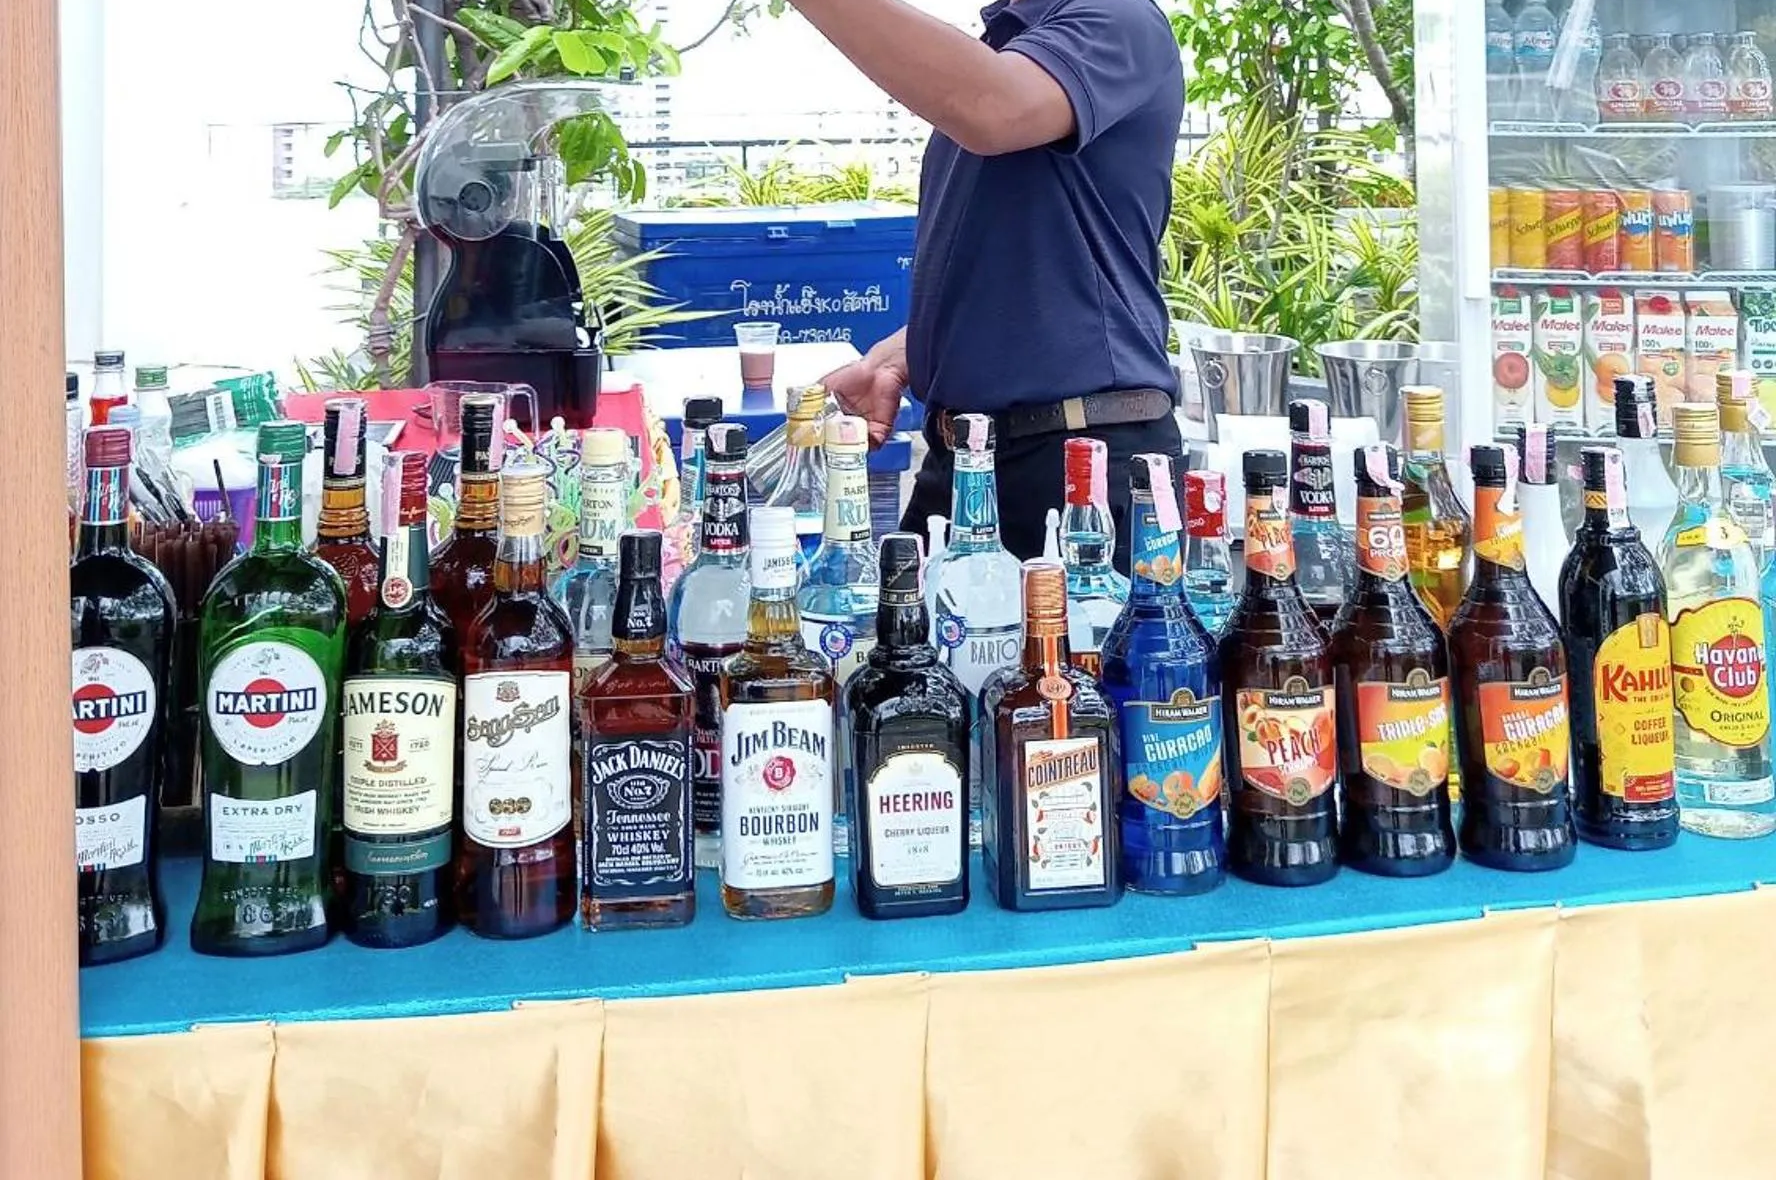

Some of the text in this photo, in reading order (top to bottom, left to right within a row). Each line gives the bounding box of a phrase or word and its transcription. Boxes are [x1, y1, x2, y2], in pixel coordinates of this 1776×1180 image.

[704, 521, 740, 536] VODKA
[1714, 667, 1757, 687] Club
[73, 693, 144, 719] RTINI
[218, 690, 314, 713] MARTINI
[1633, 717, 1667, 731] COFFEE
[731, 729, 769, 767] JIM
[771, 720, 826, 761] BEAM
[1267, 727, 1320, 765] PEACH
[591, 751, 629, 785] JACK
[1028, 746, 1097, 788] COINTREAU
[378, 777, 428, 788] DISTILLED
[222, 804, 303, 817] EXTRA DRY
[879, 791, 954, 814] HEERING
[75, 812, 121, 825] OSSO
[606, 809, 672, 825] Tennessee
[740, 811, 819, 837] BOURBON
[606, 829, 671, 843] WHISKEY
[884, 825, 950, 839] CHERRY LIQUEUR
